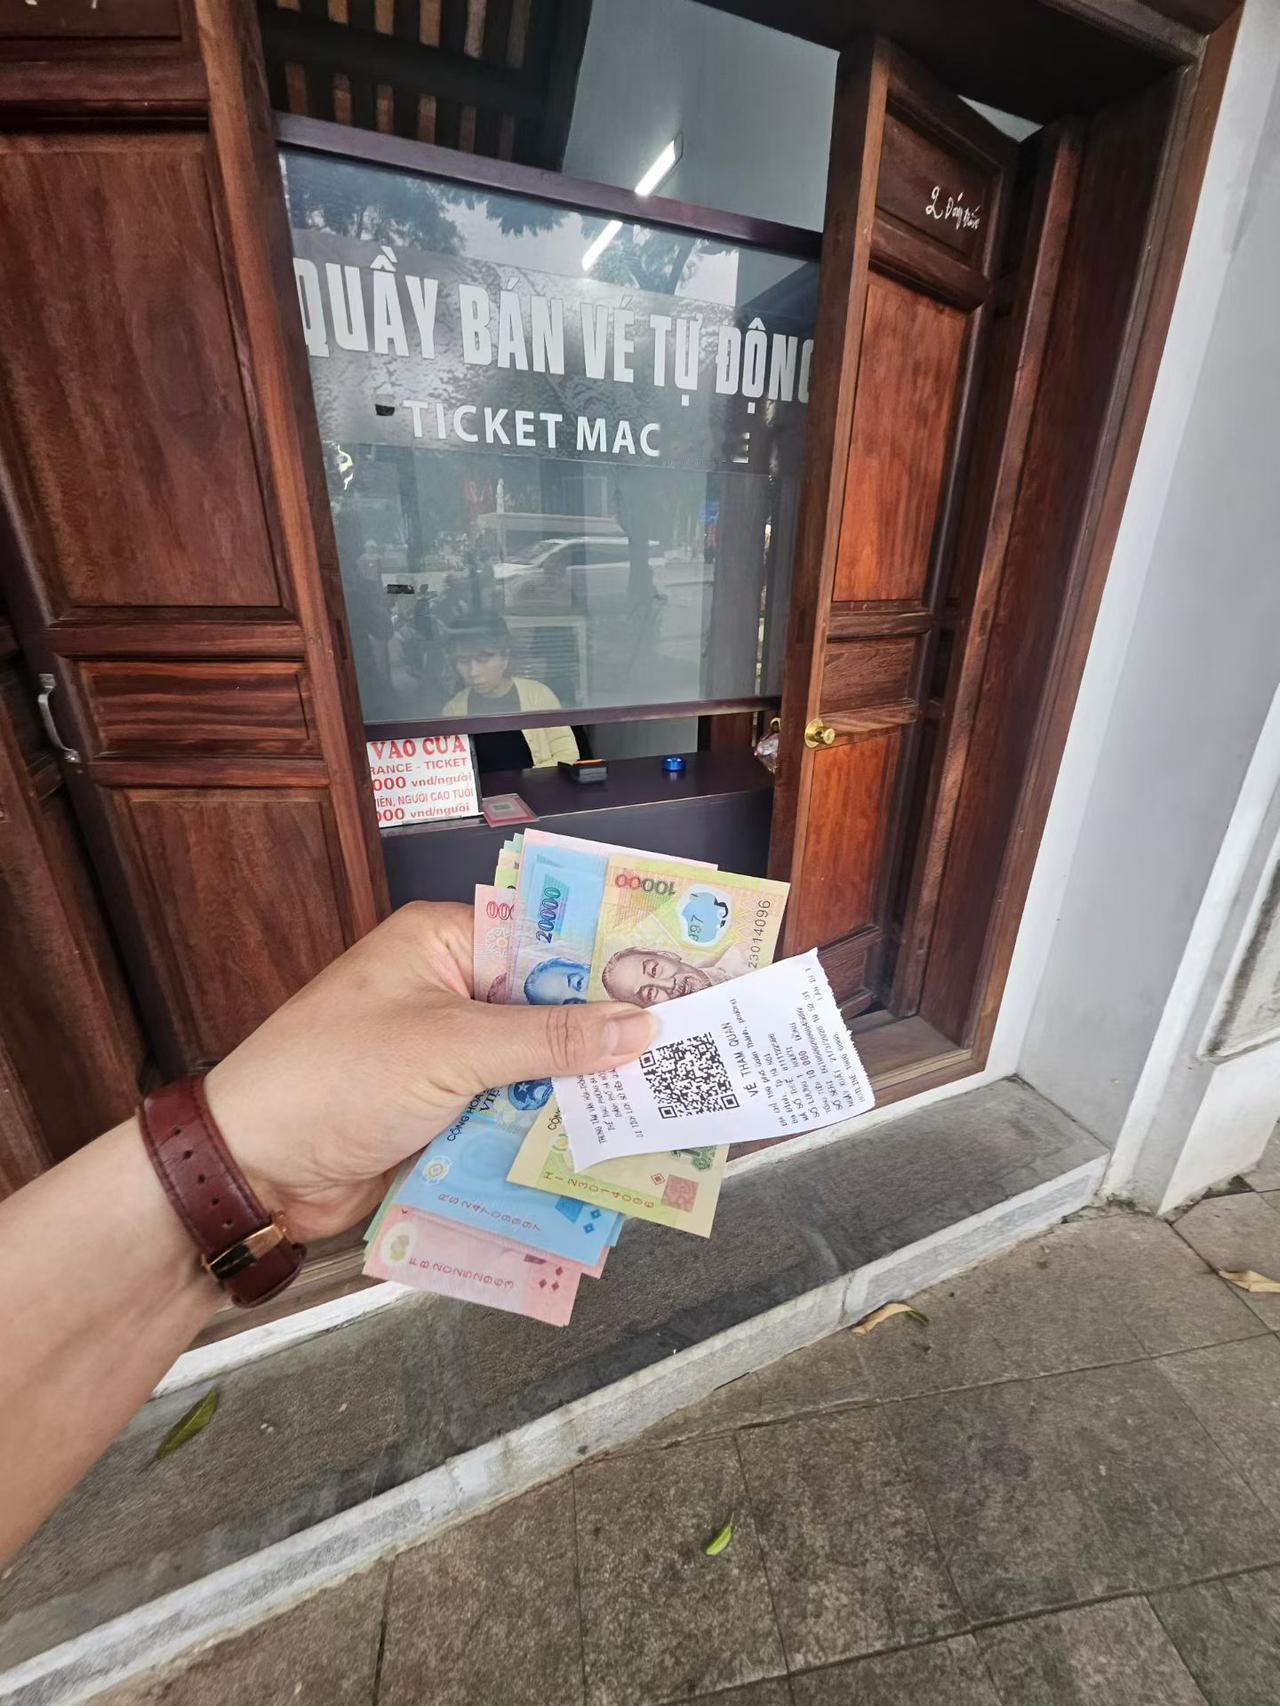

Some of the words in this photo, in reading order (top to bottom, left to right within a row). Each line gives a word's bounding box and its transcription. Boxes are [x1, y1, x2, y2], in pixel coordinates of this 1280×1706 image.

[458, 277, 565, 375] BÁN
[580, 294, 635, 383] VÉ
[650, 312, 704, 406] TỰ
[403, 400, 563, 448] TICKET
[424, 757, 468, 770] TICKET
[430, 790, 450, 801] CAO
[536, 886, 561, 944] 20000
[748, 899, 771, 969] 23014096
[720, 1020, 739, 1048] QUAN
[732, 1050, 752, 1077] THAM
[743, 1081, 759, 1098] VÉ
